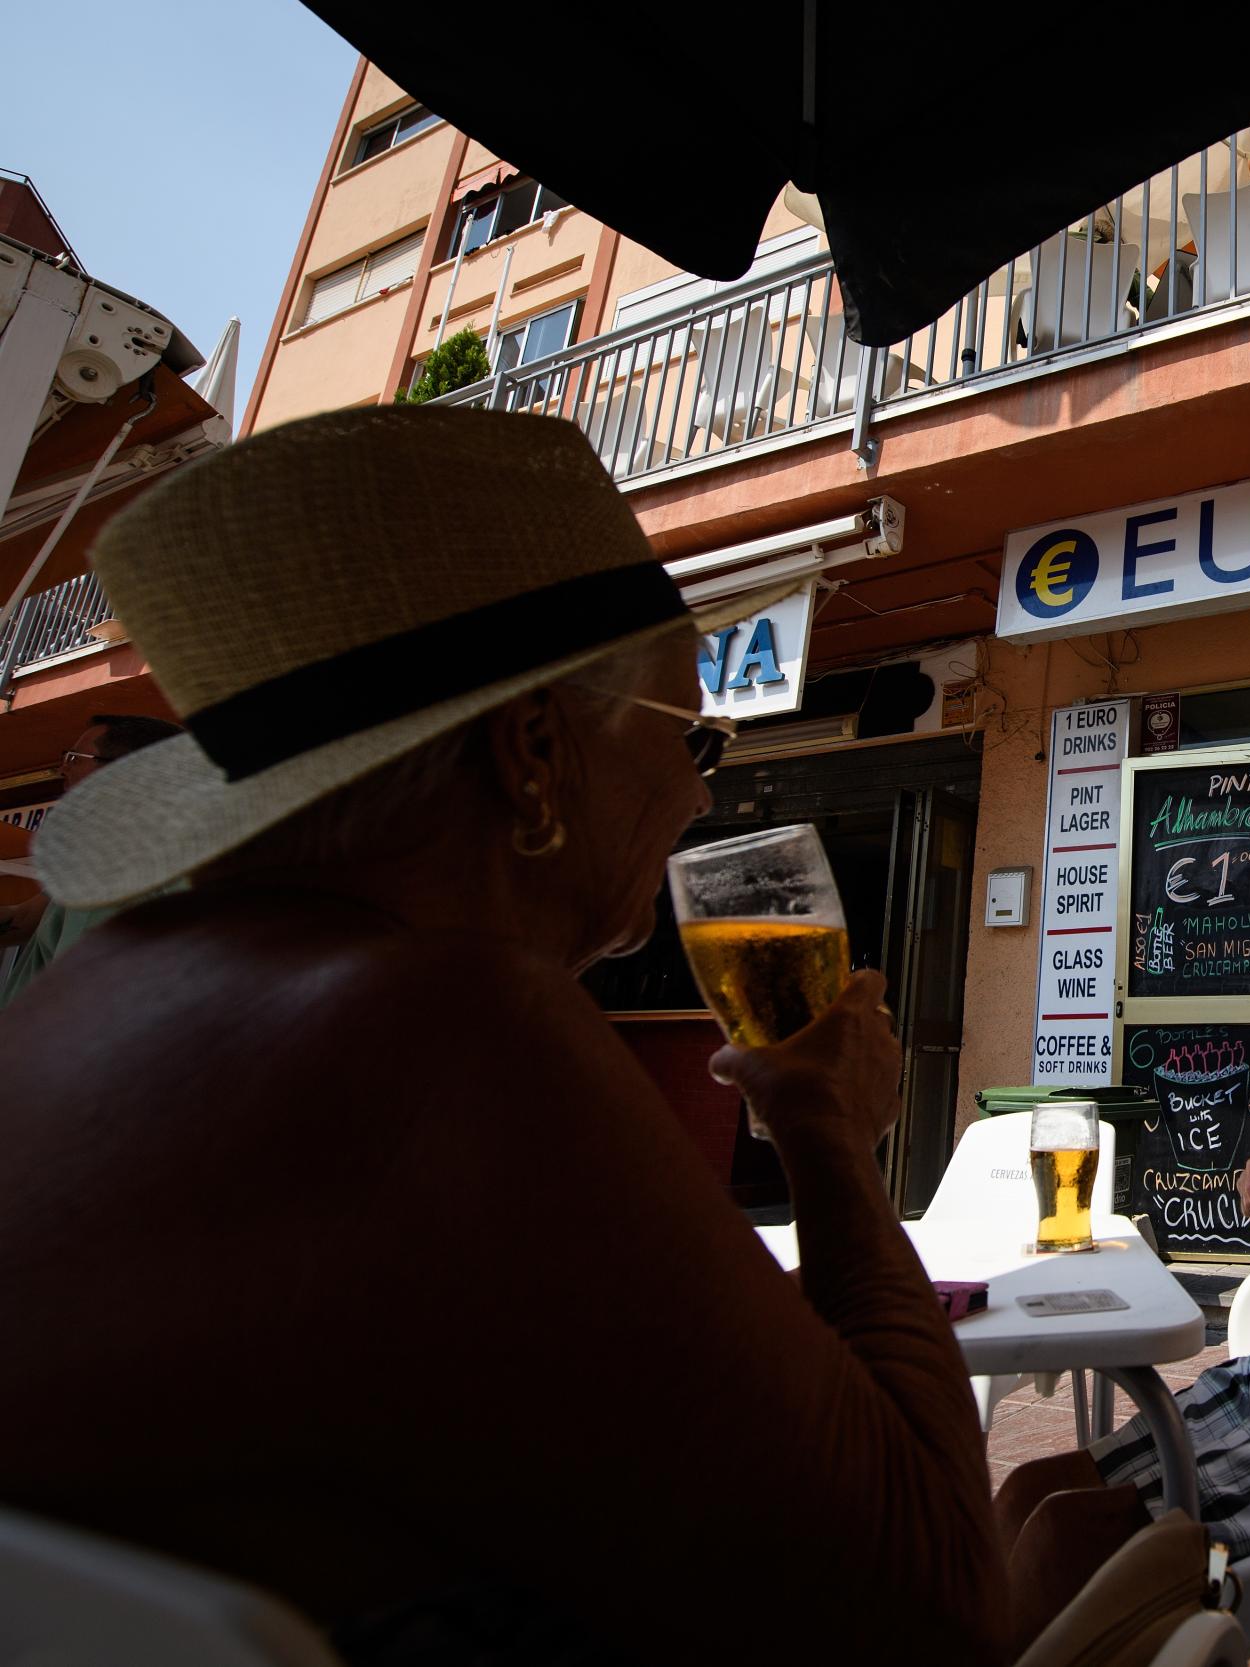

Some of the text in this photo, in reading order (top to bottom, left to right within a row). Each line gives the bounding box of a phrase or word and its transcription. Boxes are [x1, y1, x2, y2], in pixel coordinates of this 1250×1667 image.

[1066, 707, 1117, 730] 1 EURO
[1063, 733, 1117, 756] DRINKS
[1071, 785, 1104, 806] PINT
[1060, 811, 1110, 833] LAGER
[1057, 865, 1108, 886] HOUSE
[1056, 892, 1104, 915] SPIRIT
[1134, 937, 1146, 971] ALSO
[1163, 922, 1175, 972] BEER
[1053, 948, 1103, 971] GLASS
[1058, 978, 1096, 998] WINE
[1036, 1035, 1112, 1057] COFFEE &
[1129, 1029, 1154, 1069] 6
[1038, 1061, 1108, 1074] SOFT DRINKS
[1189, 1109, 1213, 1122] with
[1178, 1123, 1222, 1152] ICE
[990, 1168, 1028, 1180] CERVEZAS
